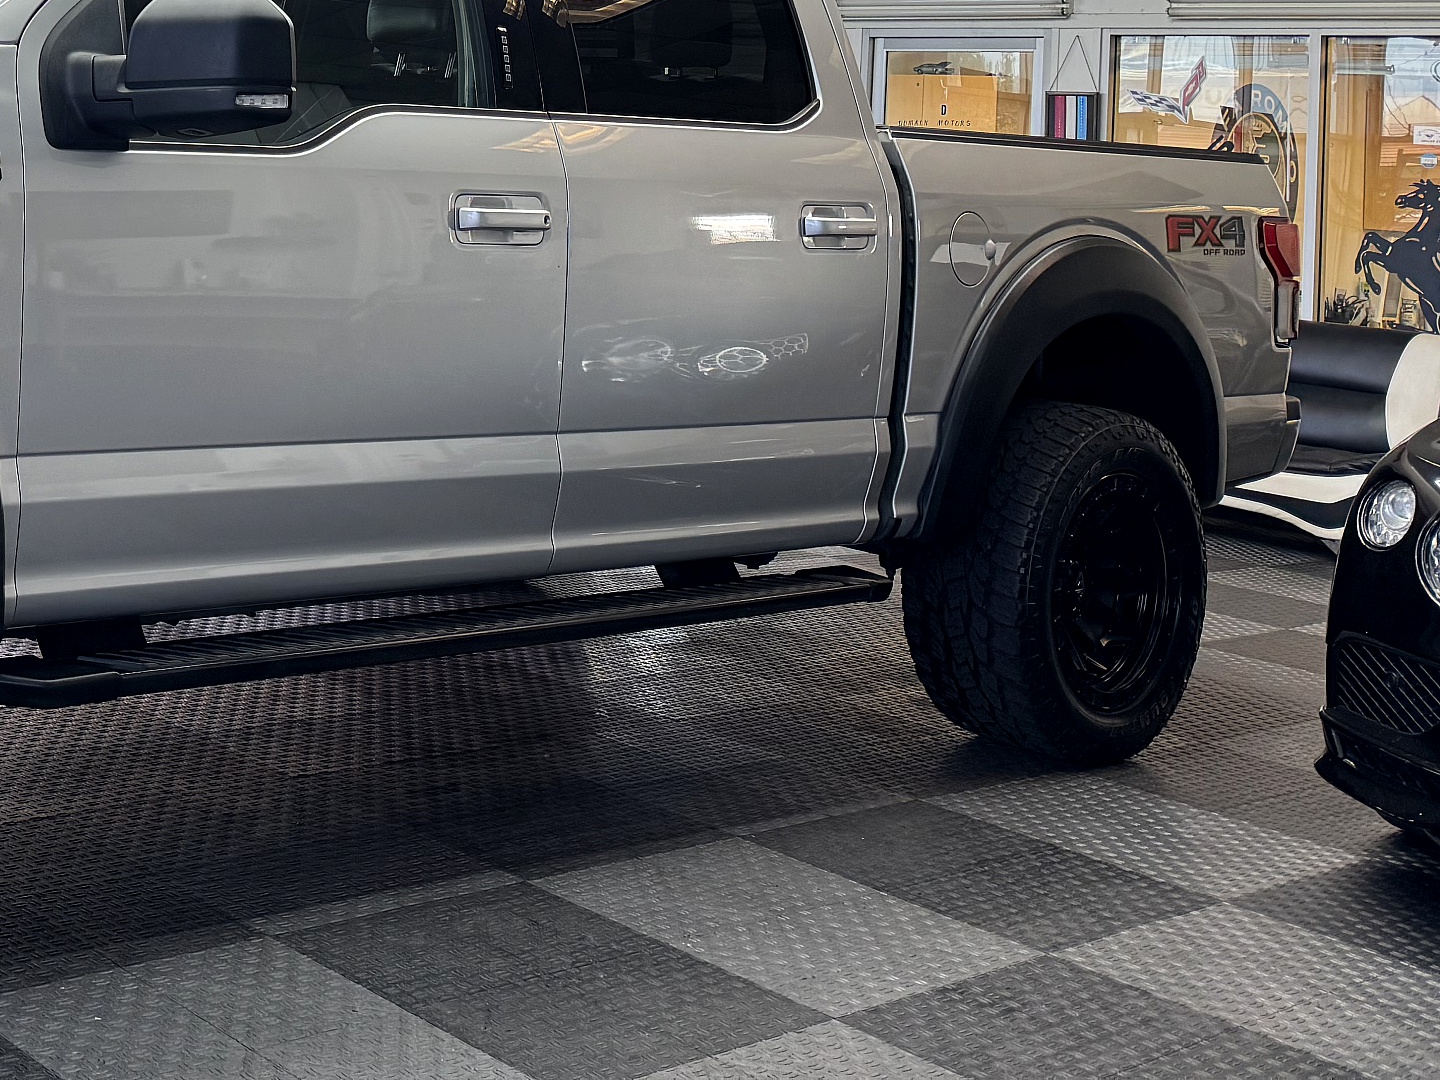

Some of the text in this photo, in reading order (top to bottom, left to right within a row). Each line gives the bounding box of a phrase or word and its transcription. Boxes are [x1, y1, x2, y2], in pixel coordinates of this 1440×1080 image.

[1165, 214, 1246, 253] FX4
[1203, 248, 1246, 256] OFF ROAD
